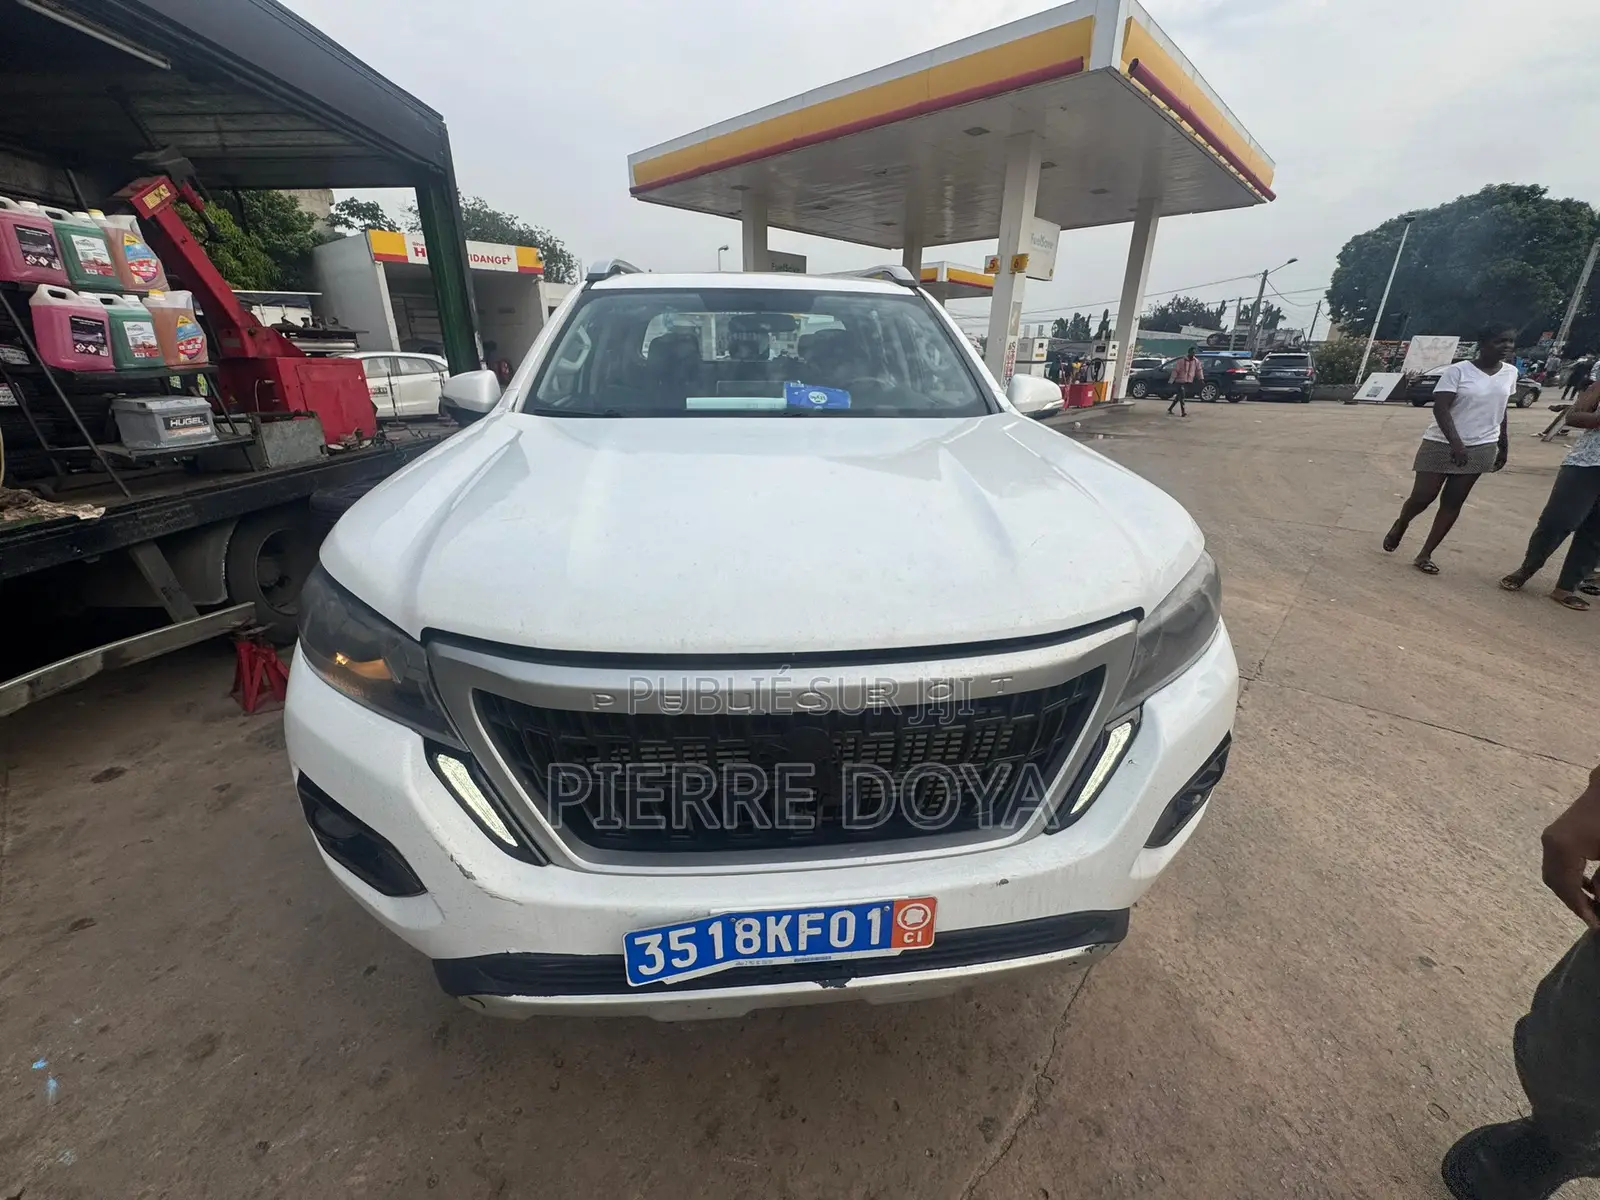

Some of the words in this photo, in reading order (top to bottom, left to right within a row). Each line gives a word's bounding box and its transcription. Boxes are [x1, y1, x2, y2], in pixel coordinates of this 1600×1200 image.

[988, 257, 997, 268] 5
[170, 416, 204, 427] HUGEL
[592, 676, 1013, 710] PEUGEOT
[633, 907, 882, 976] 3518KF01
[903, 931, 922, 944] CI
